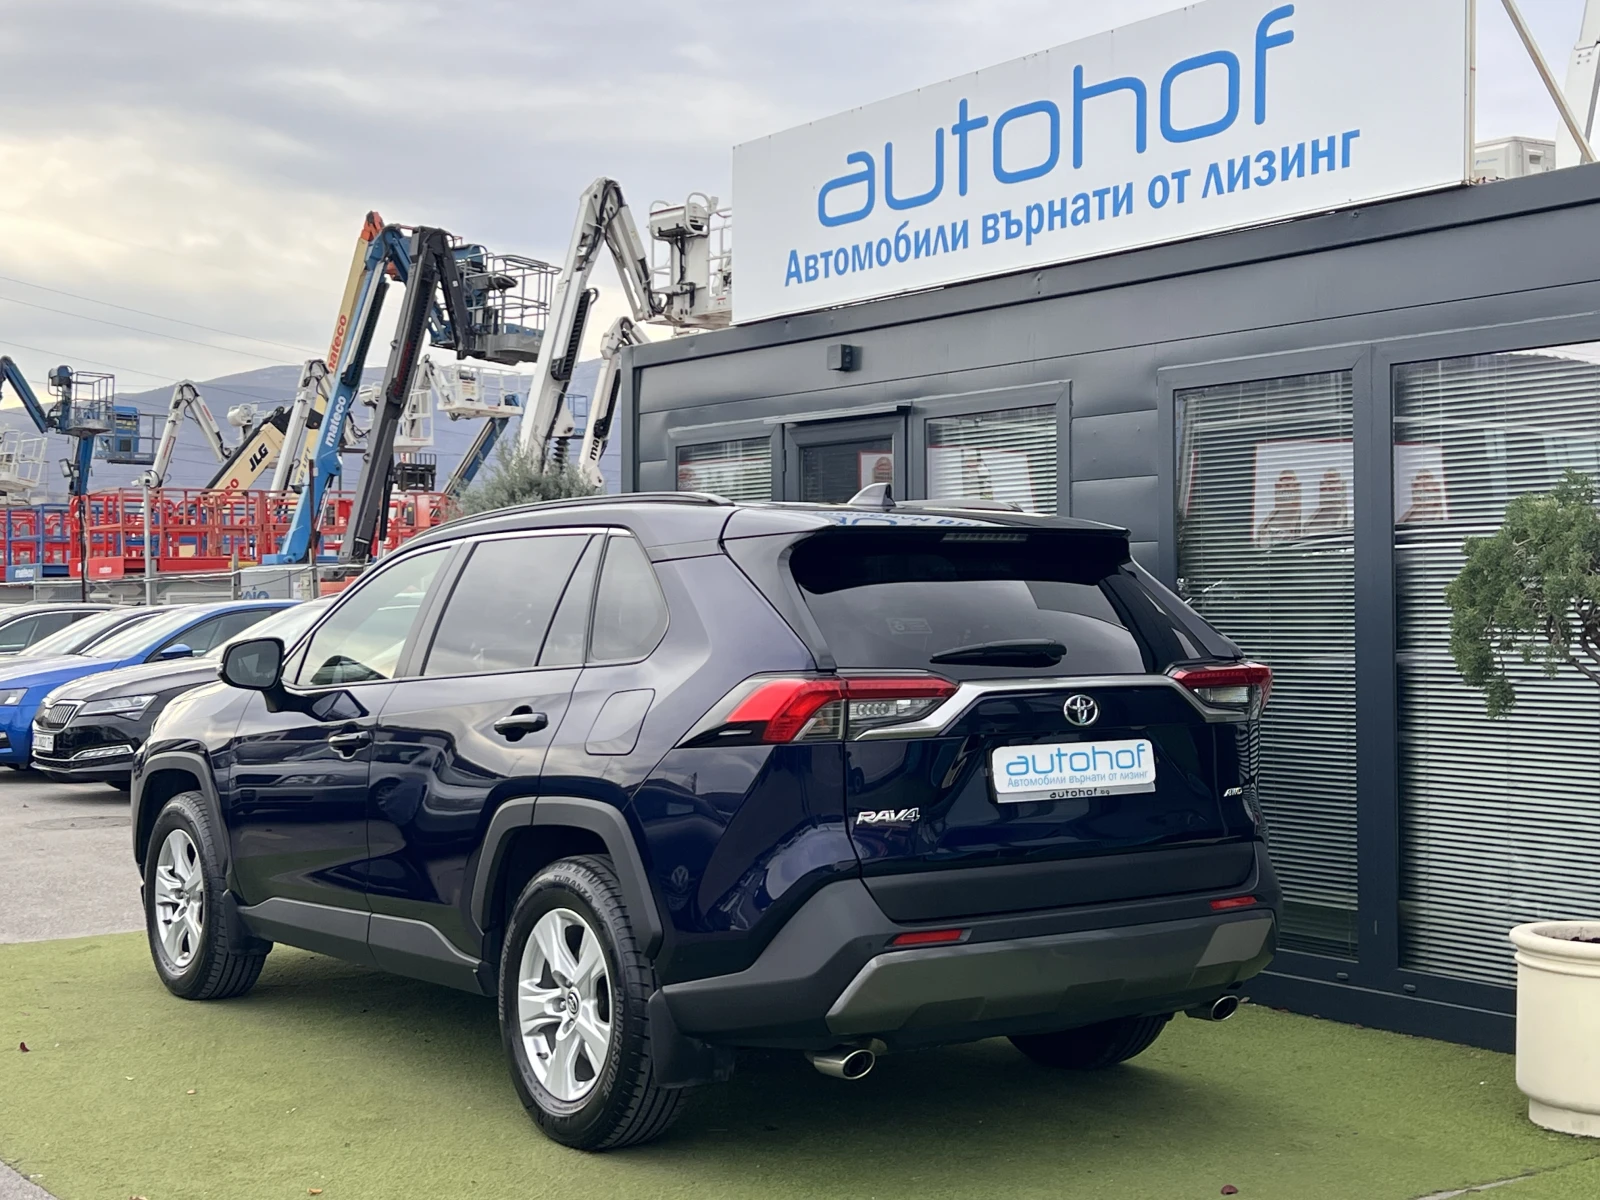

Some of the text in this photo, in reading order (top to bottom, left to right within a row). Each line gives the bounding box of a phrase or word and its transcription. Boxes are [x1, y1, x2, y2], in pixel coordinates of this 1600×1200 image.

[818, 4, 1294, 227] autohof
[785, 130, 1361, 286] Автомобили върнати от лизинг
[325, 395, 347, 447] mateco
[249, 442, 269, 473] JLG
[1005, 743, 1146, 776] autohof
[1007, 770, 1149, 788] Автомобили върнати от лизинг
[856, 807, 920, 825] RAV4
[554, 874, 594, 905] TURANZA
